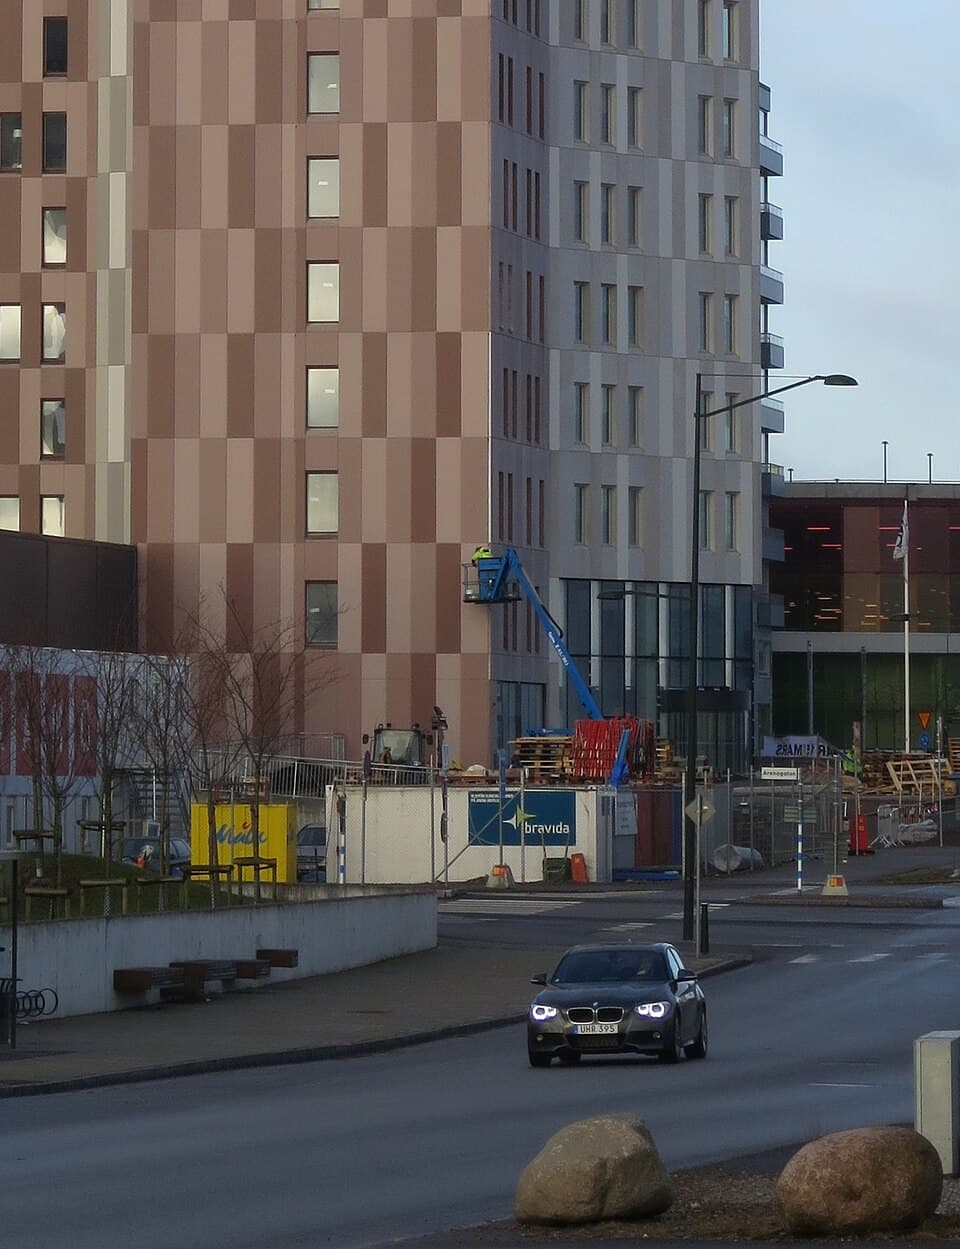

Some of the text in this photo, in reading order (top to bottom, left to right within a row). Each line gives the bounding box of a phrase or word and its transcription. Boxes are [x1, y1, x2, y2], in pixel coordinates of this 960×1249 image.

[525, 822, 570, 834] bravida
[580, 1024, 615, 1033] UHR 395
